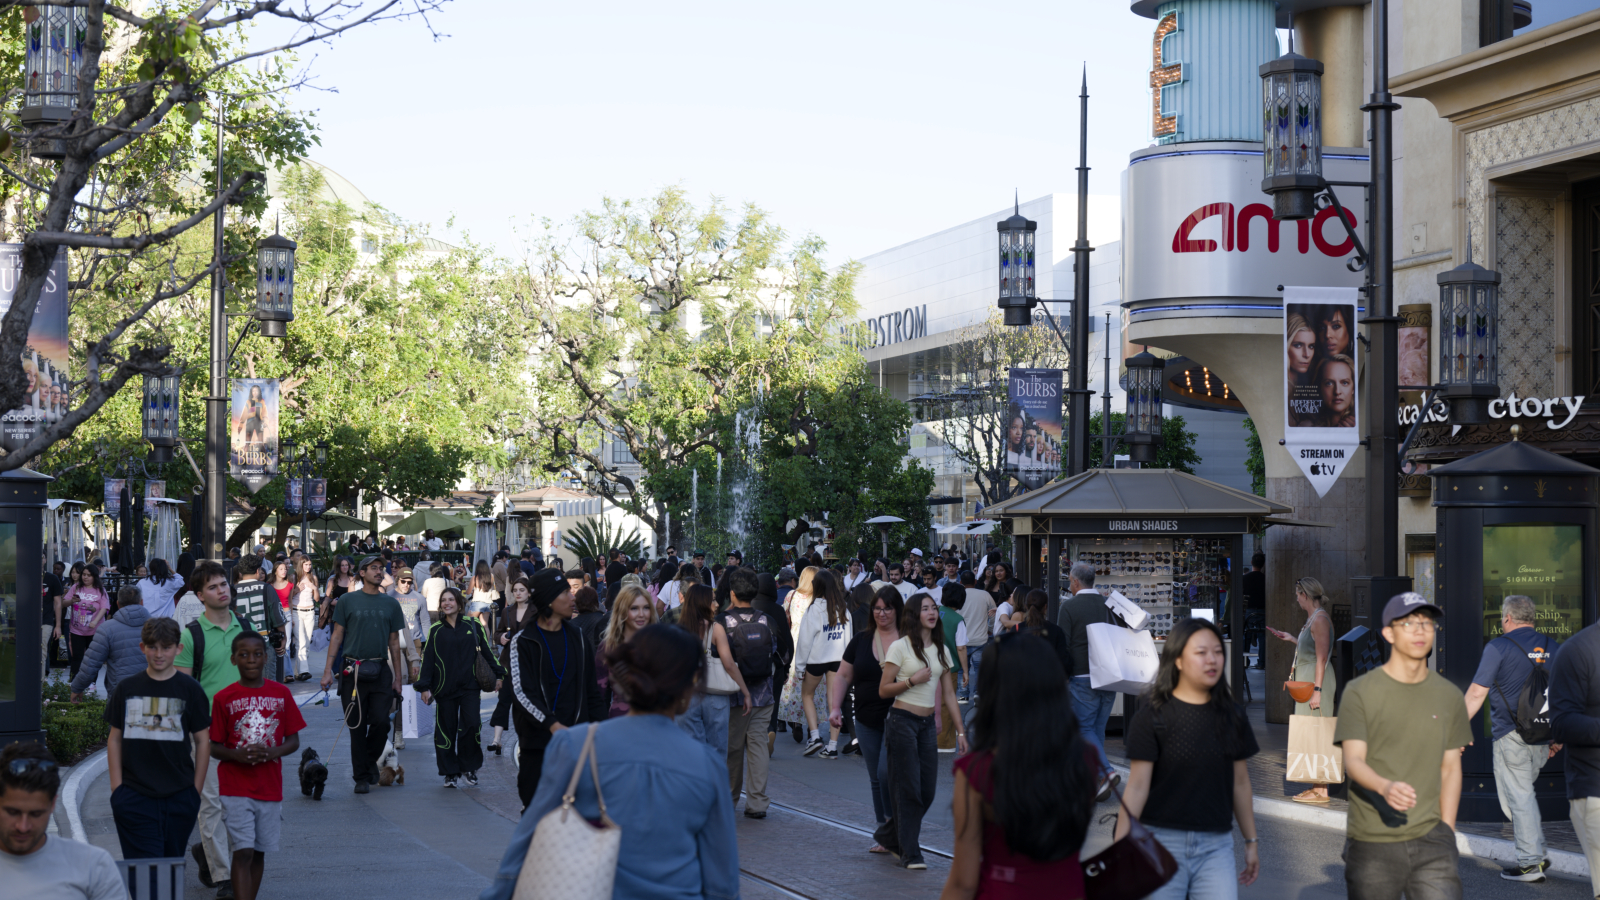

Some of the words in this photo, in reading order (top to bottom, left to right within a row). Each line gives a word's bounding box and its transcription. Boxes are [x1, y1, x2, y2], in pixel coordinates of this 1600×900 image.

[1171, 202, 1358, 258] amc
[1030, 374, 1042, 383] The
[1300, 449, 1333, 459] STREAM
[1333, 449, 1345, 459] ON
[1321, 462, 1336, 476] tv
[1108, 520, 1140, 531] URBAN
[1141, 520, 1178, 531] SHADES
[1535, 623, 1572, 634] ewards.
[827, 631, 843, 641] FOX
[1125, 648, 1150, 659] RIMOWA
[1286, 752, 1342, 782] ZARA
